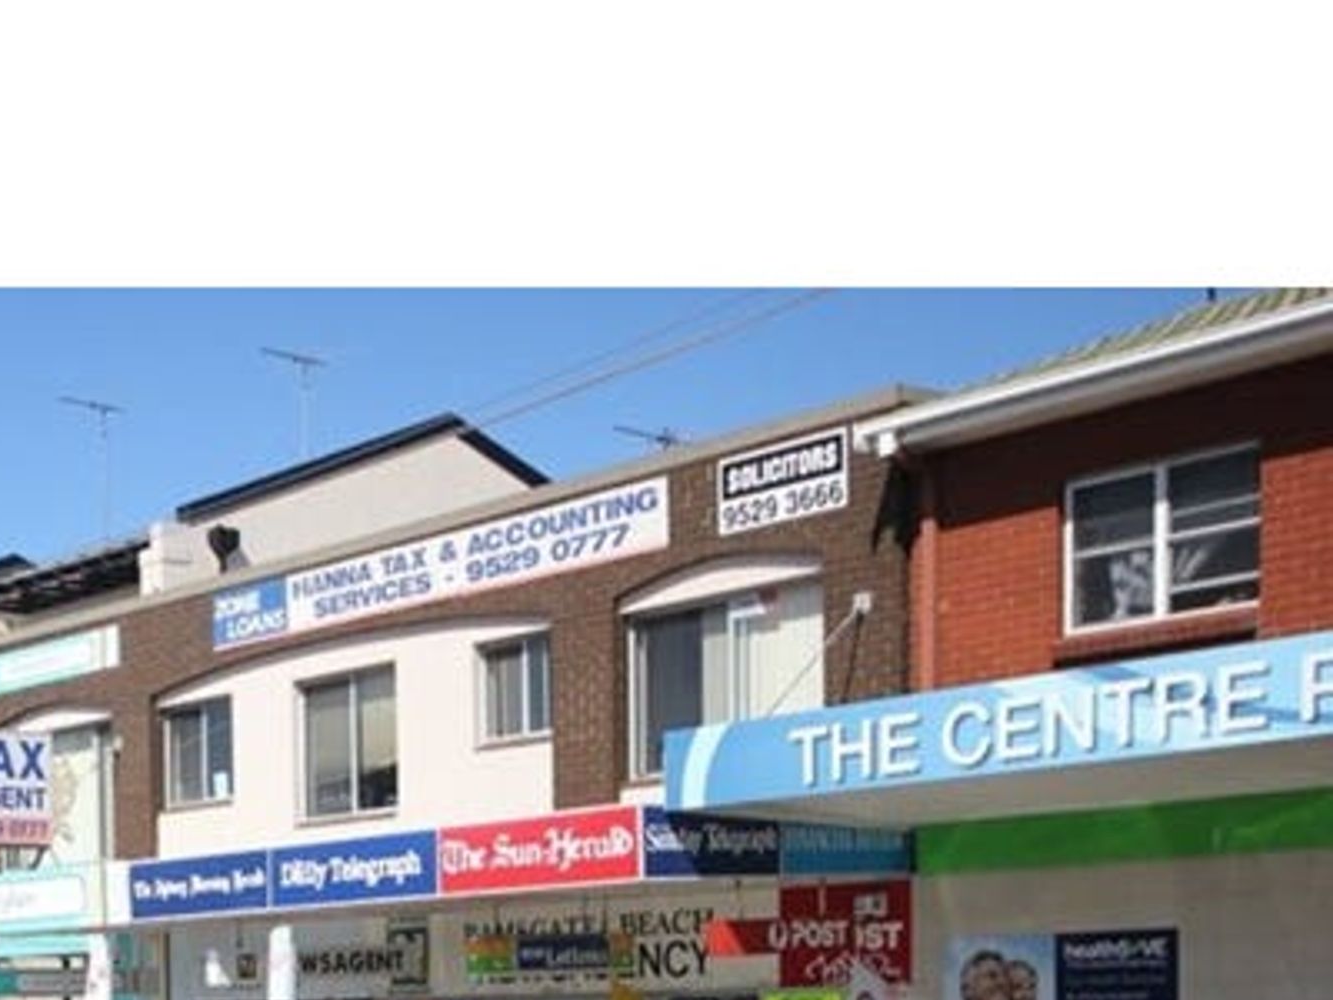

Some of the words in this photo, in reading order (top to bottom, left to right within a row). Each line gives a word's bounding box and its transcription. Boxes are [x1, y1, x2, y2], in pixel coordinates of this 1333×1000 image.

[727, 441, 837, 494] SOLICITORS
[292, 564, 370, 599] HANNA
[382, 551, 427, 577] TAX
[439, 540, 458, 562] &
[468, 486, 659, 554] ACCOUNTING
[314, 571, 431, 618] SERVICES
[466, 547, 541, 583] 9529
[551, 524, 631, 562] 0777
[225, 610, 287, 640] LOANS
[787, 711, 923, 788] THE
[941, 661, 1272, 767] CENTRE
[441, 839, 487, 875] The
[619, 907, 714, 936] BEACH
[791, 920, 849, 948] POST
[298, 949, 404, 976] WSAGENT
